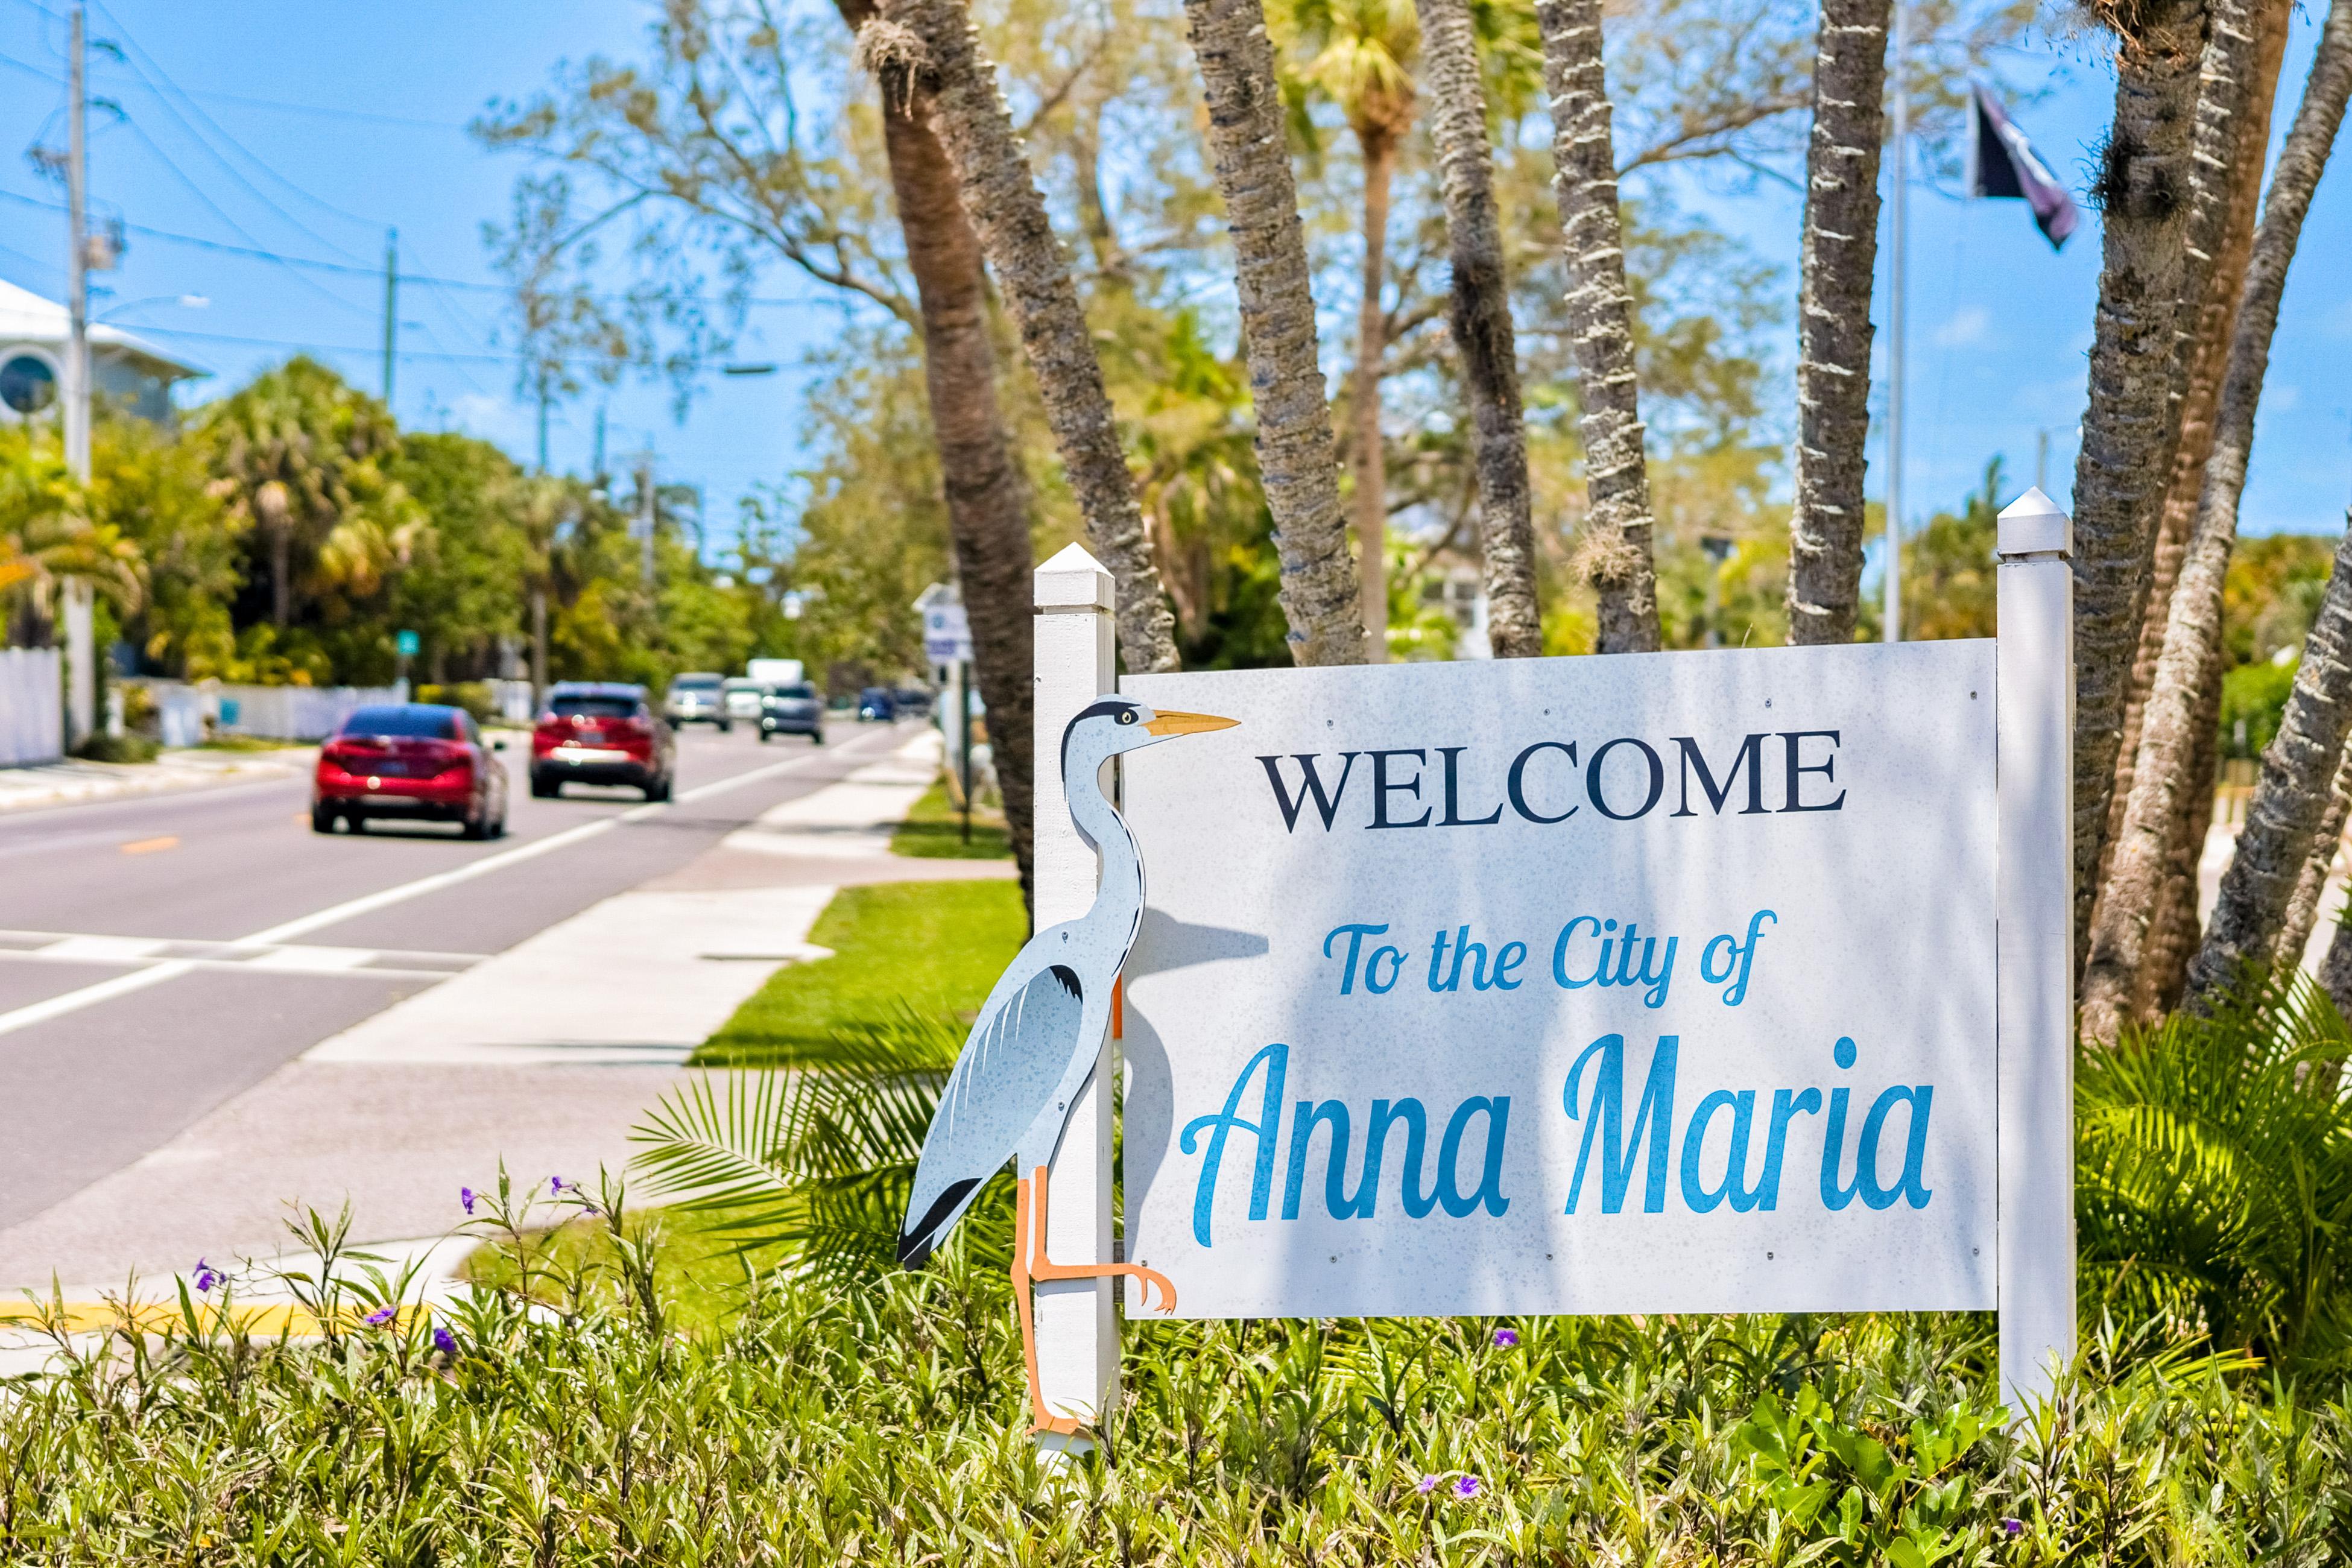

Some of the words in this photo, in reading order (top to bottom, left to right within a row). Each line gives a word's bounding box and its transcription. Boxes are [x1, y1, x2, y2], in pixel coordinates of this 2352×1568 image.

[1255, 730, 1847, 834] WELCOME
[1323, 923, 1409, 996] To
[1427, 924, 1527, 993] the
[1552, 915, 1679, 1009] City
[1699, 909, 1778, 1007] of
[1180, 1042, 1511, 1248] Anna
[1563, 1033, 1934, 1215] Maria
